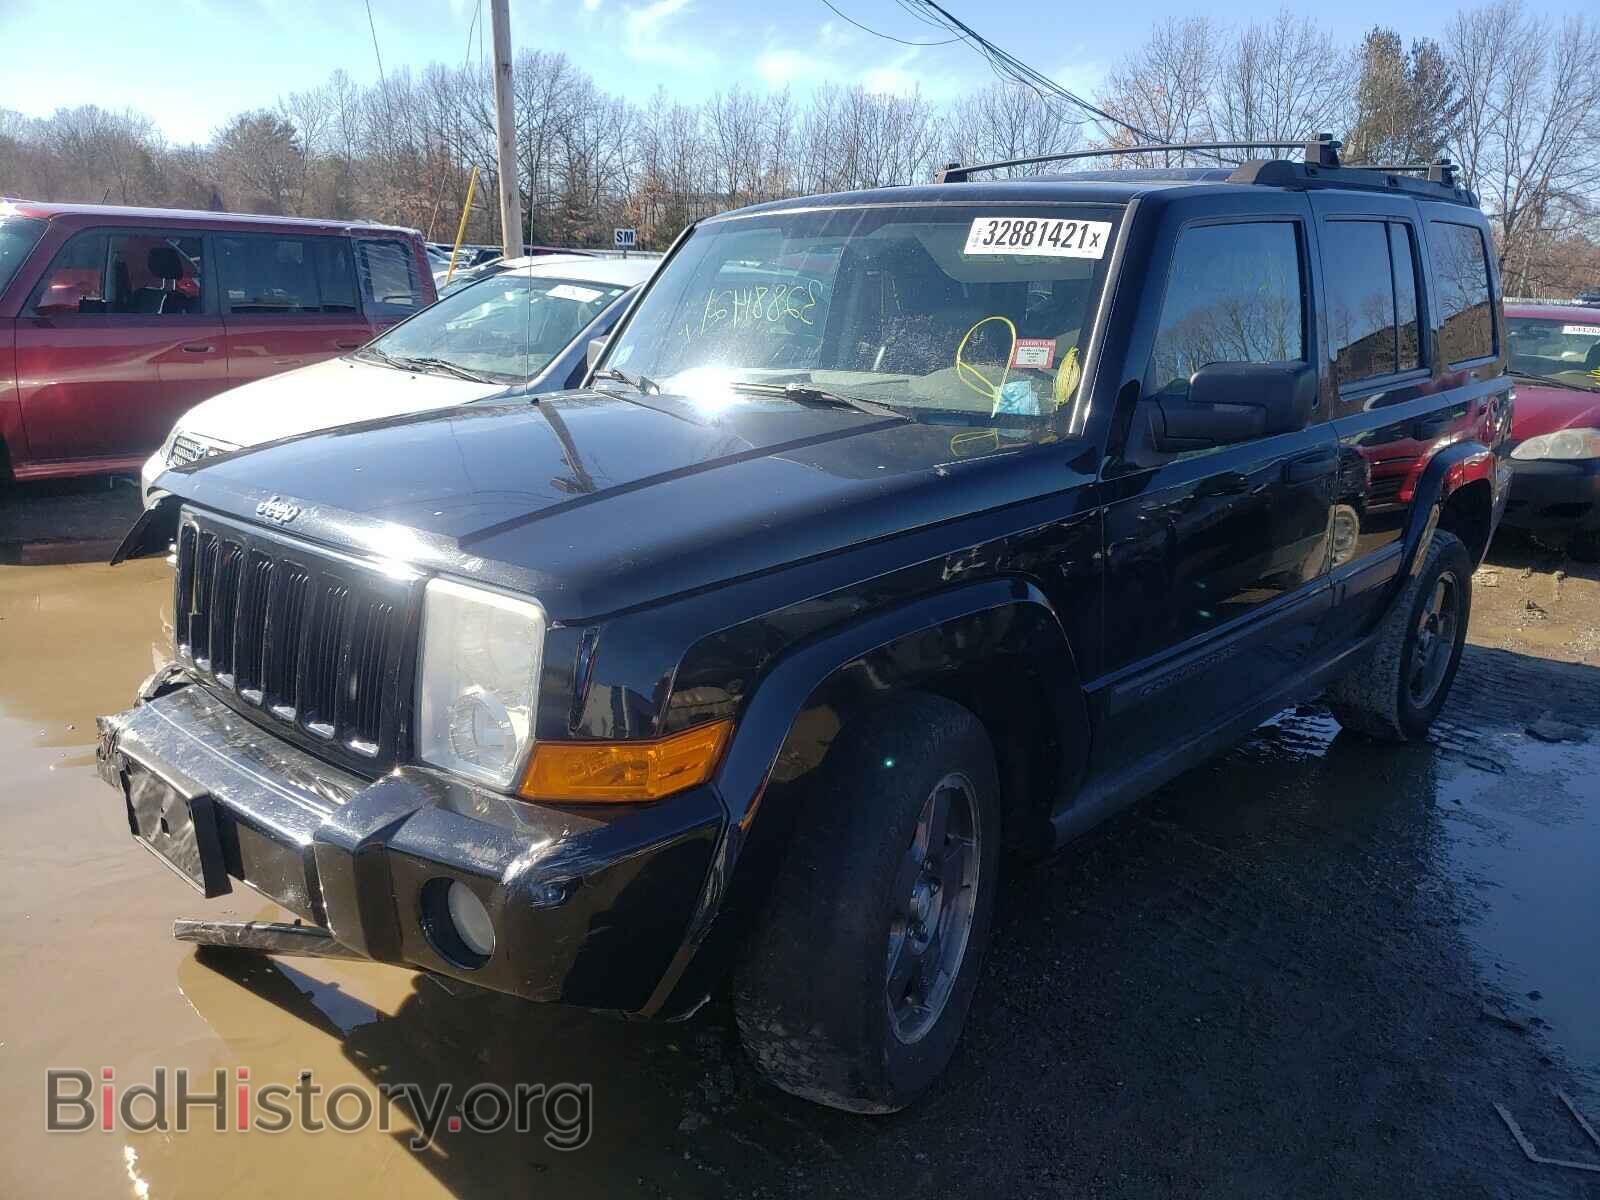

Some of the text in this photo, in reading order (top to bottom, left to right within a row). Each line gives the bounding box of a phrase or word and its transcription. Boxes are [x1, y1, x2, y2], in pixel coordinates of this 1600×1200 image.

[616, 231, 634, 243] SM
[983, 220, 1089, 248] 32881421
[256, 495, 302, 525] Jeep
